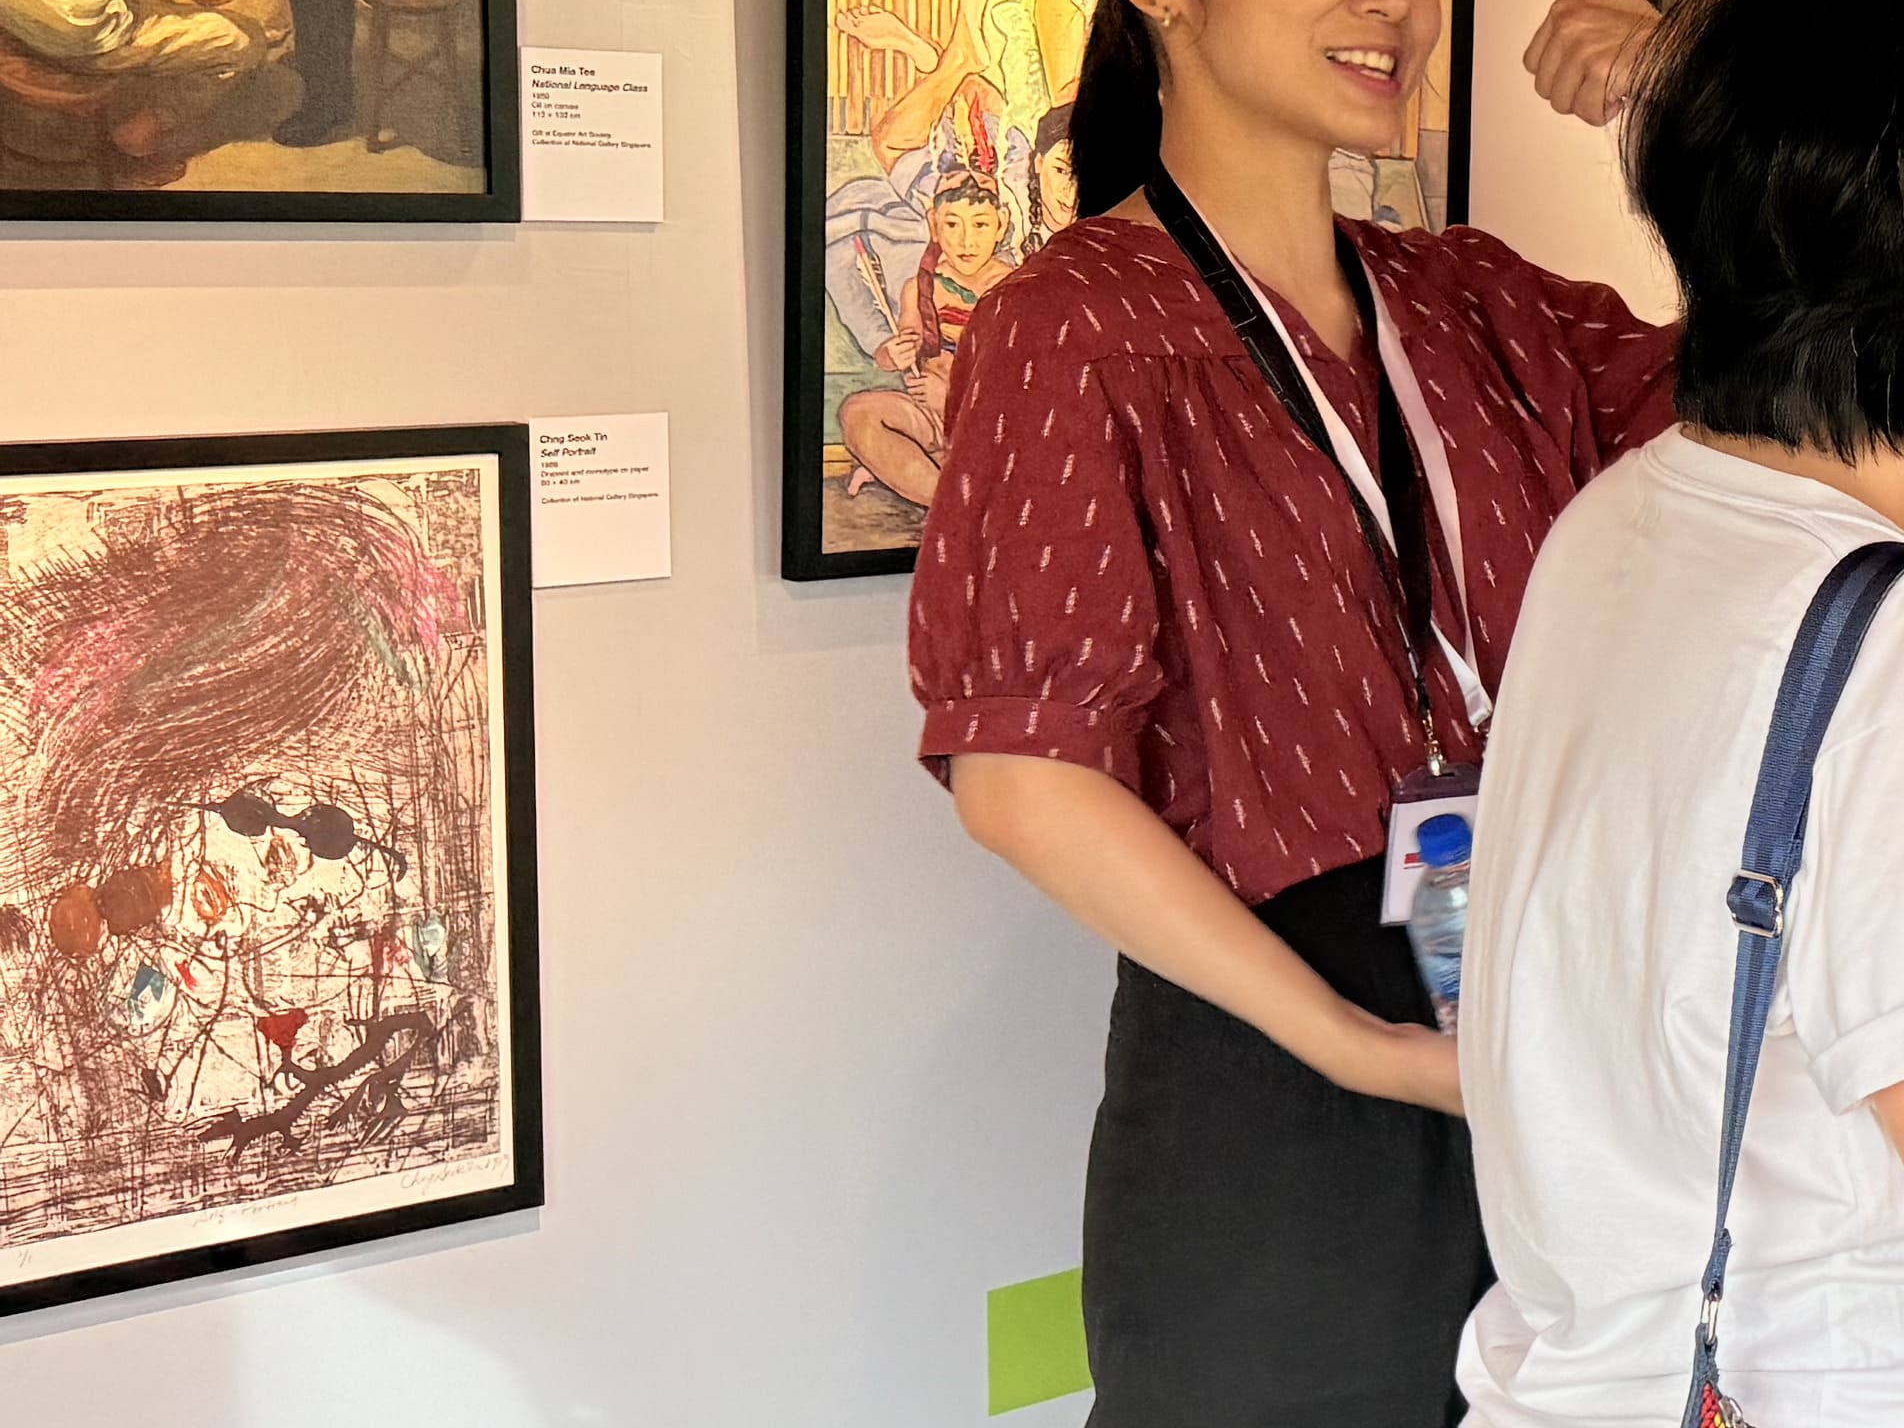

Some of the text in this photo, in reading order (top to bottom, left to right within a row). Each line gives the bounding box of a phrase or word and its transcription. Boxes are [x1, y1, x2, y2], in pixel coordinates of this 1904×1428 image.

[531, 65, 595, 76] Chua Mia Tee
[532, 79, 648, 92] National Language Class
[539, 432, 608, 444] Chng Seok Tin
[540, 447, 596, 458] Self Portrait
